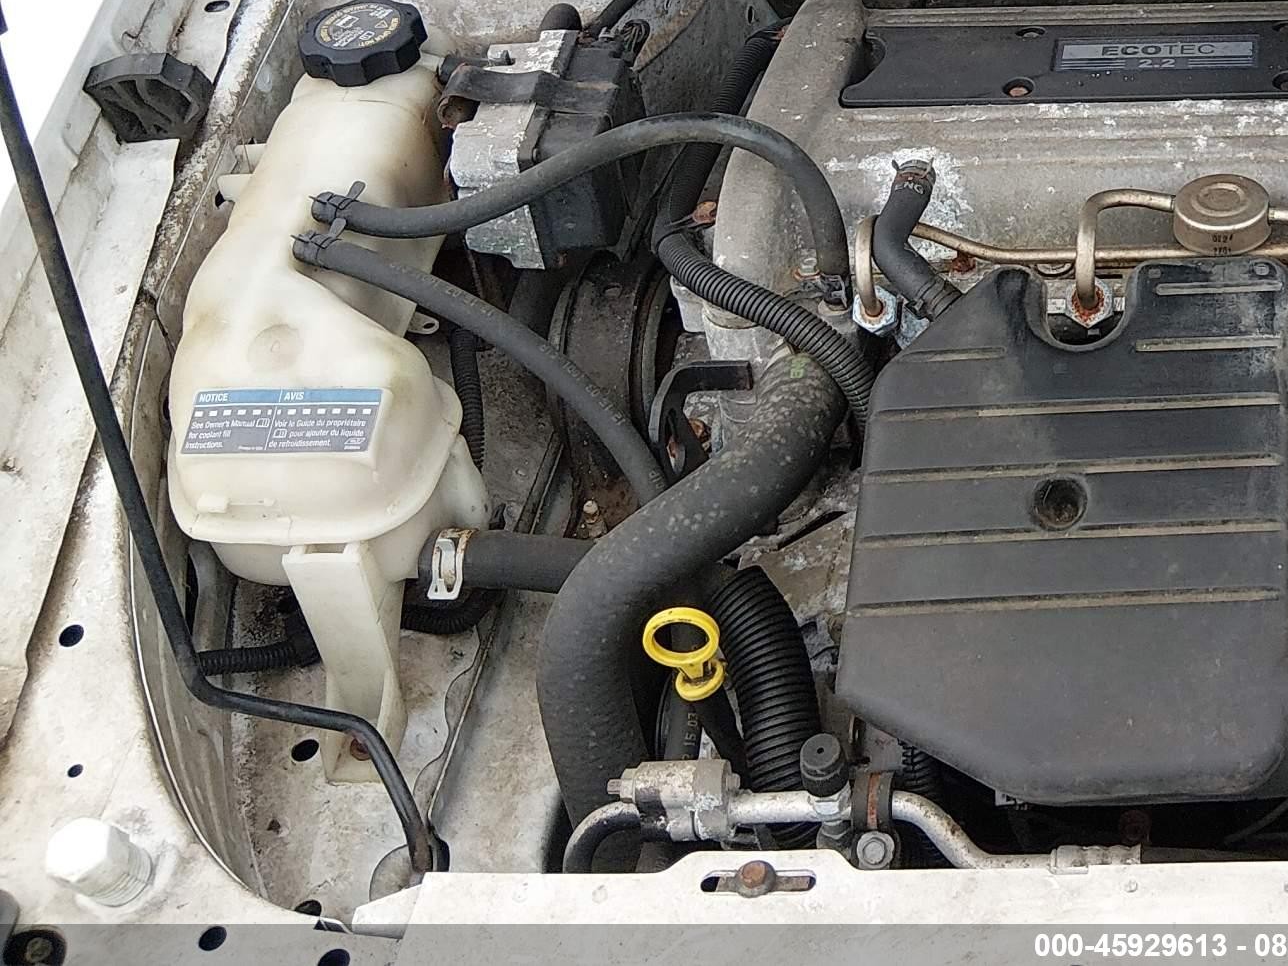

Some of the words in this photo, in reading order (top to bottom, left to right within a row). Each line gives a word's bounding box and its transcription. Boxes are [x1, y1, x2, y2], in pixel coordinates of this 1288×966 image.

[1102, 43, 1215, 56] ECOTEC
[1137, 58, 1176, 69] 2.2
[199, 393, 228, 402] NOTICE
[284, 392, 305, 400] AVIS
[205, 421, 230, 429] Owner's
[199, 431, 222, 439] coolant
[223, 430, 231, 438] fill
[269, 440, 277, 448] de
[278, 440, 331, 448] refroidissement.
